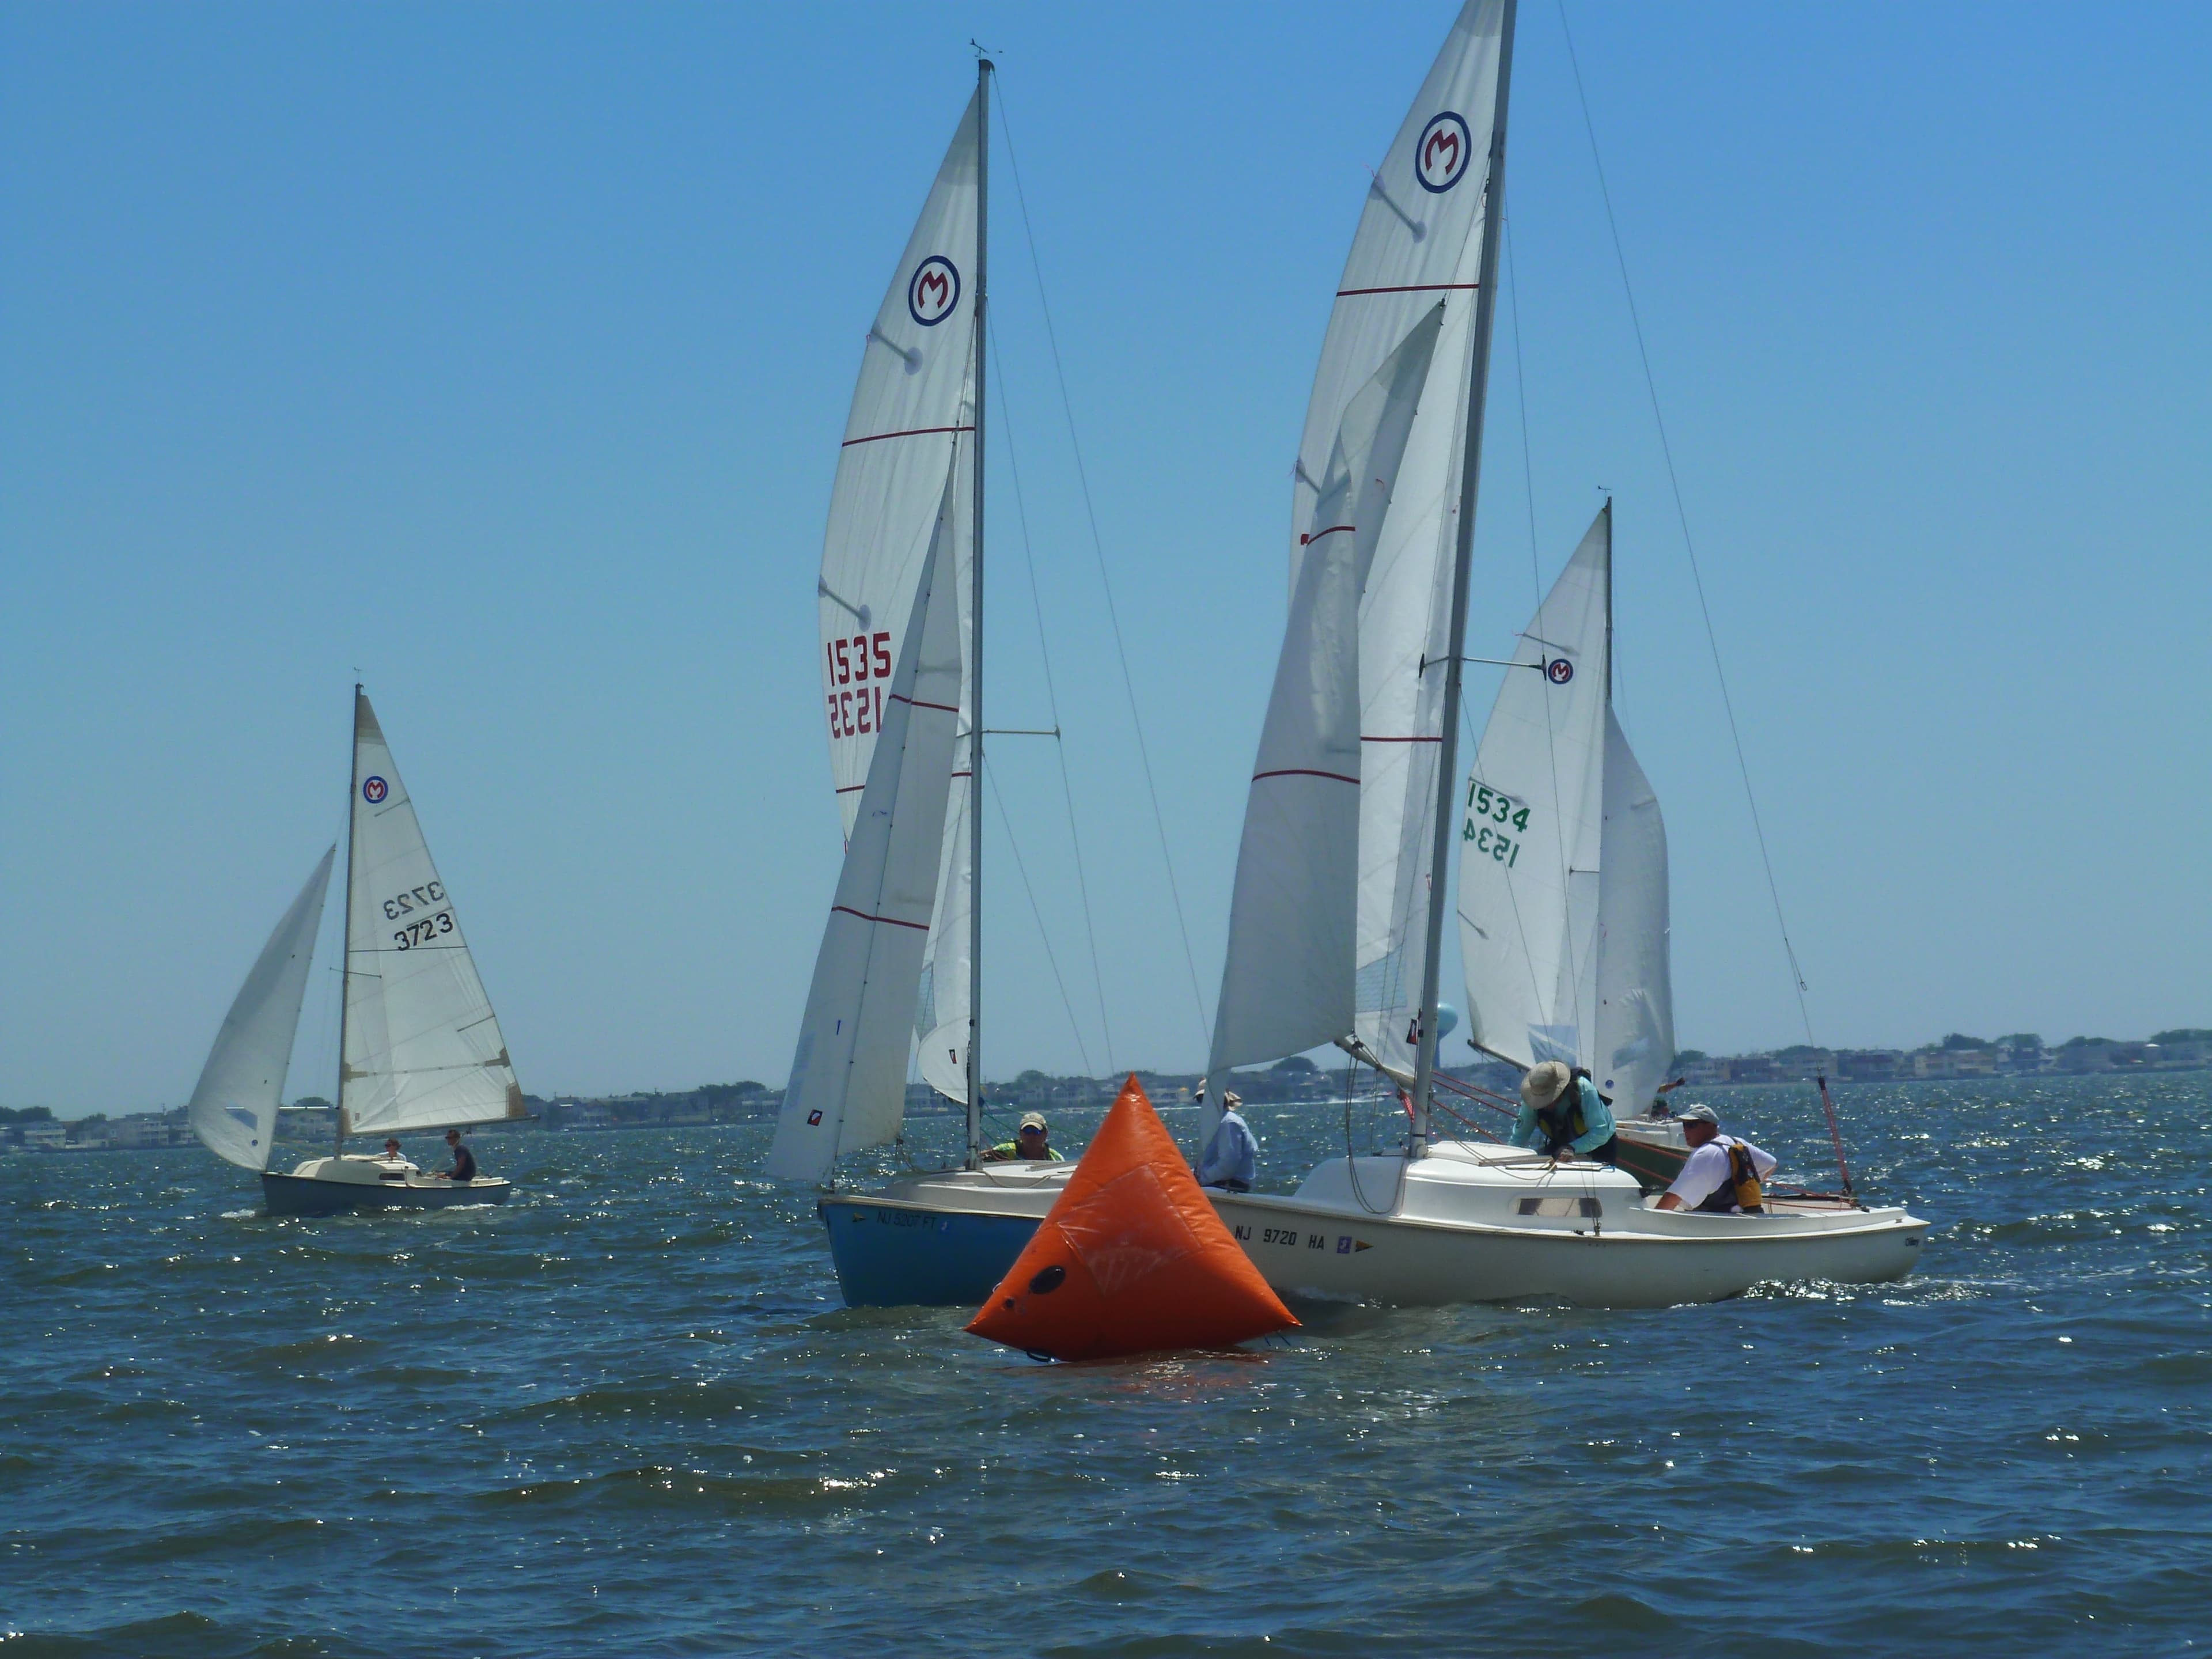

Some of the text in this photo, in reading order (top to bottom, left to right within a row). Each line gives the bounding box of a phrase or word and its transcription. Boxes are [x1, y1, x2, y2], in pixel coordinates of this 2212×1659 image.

[827, 632, 891, 687] 1535
[1468, 783, 1531, 833] 1534
[394, 913, 453, 950] 3723
[1235, 1225, 1324, 1250] NJ 9720 HA
